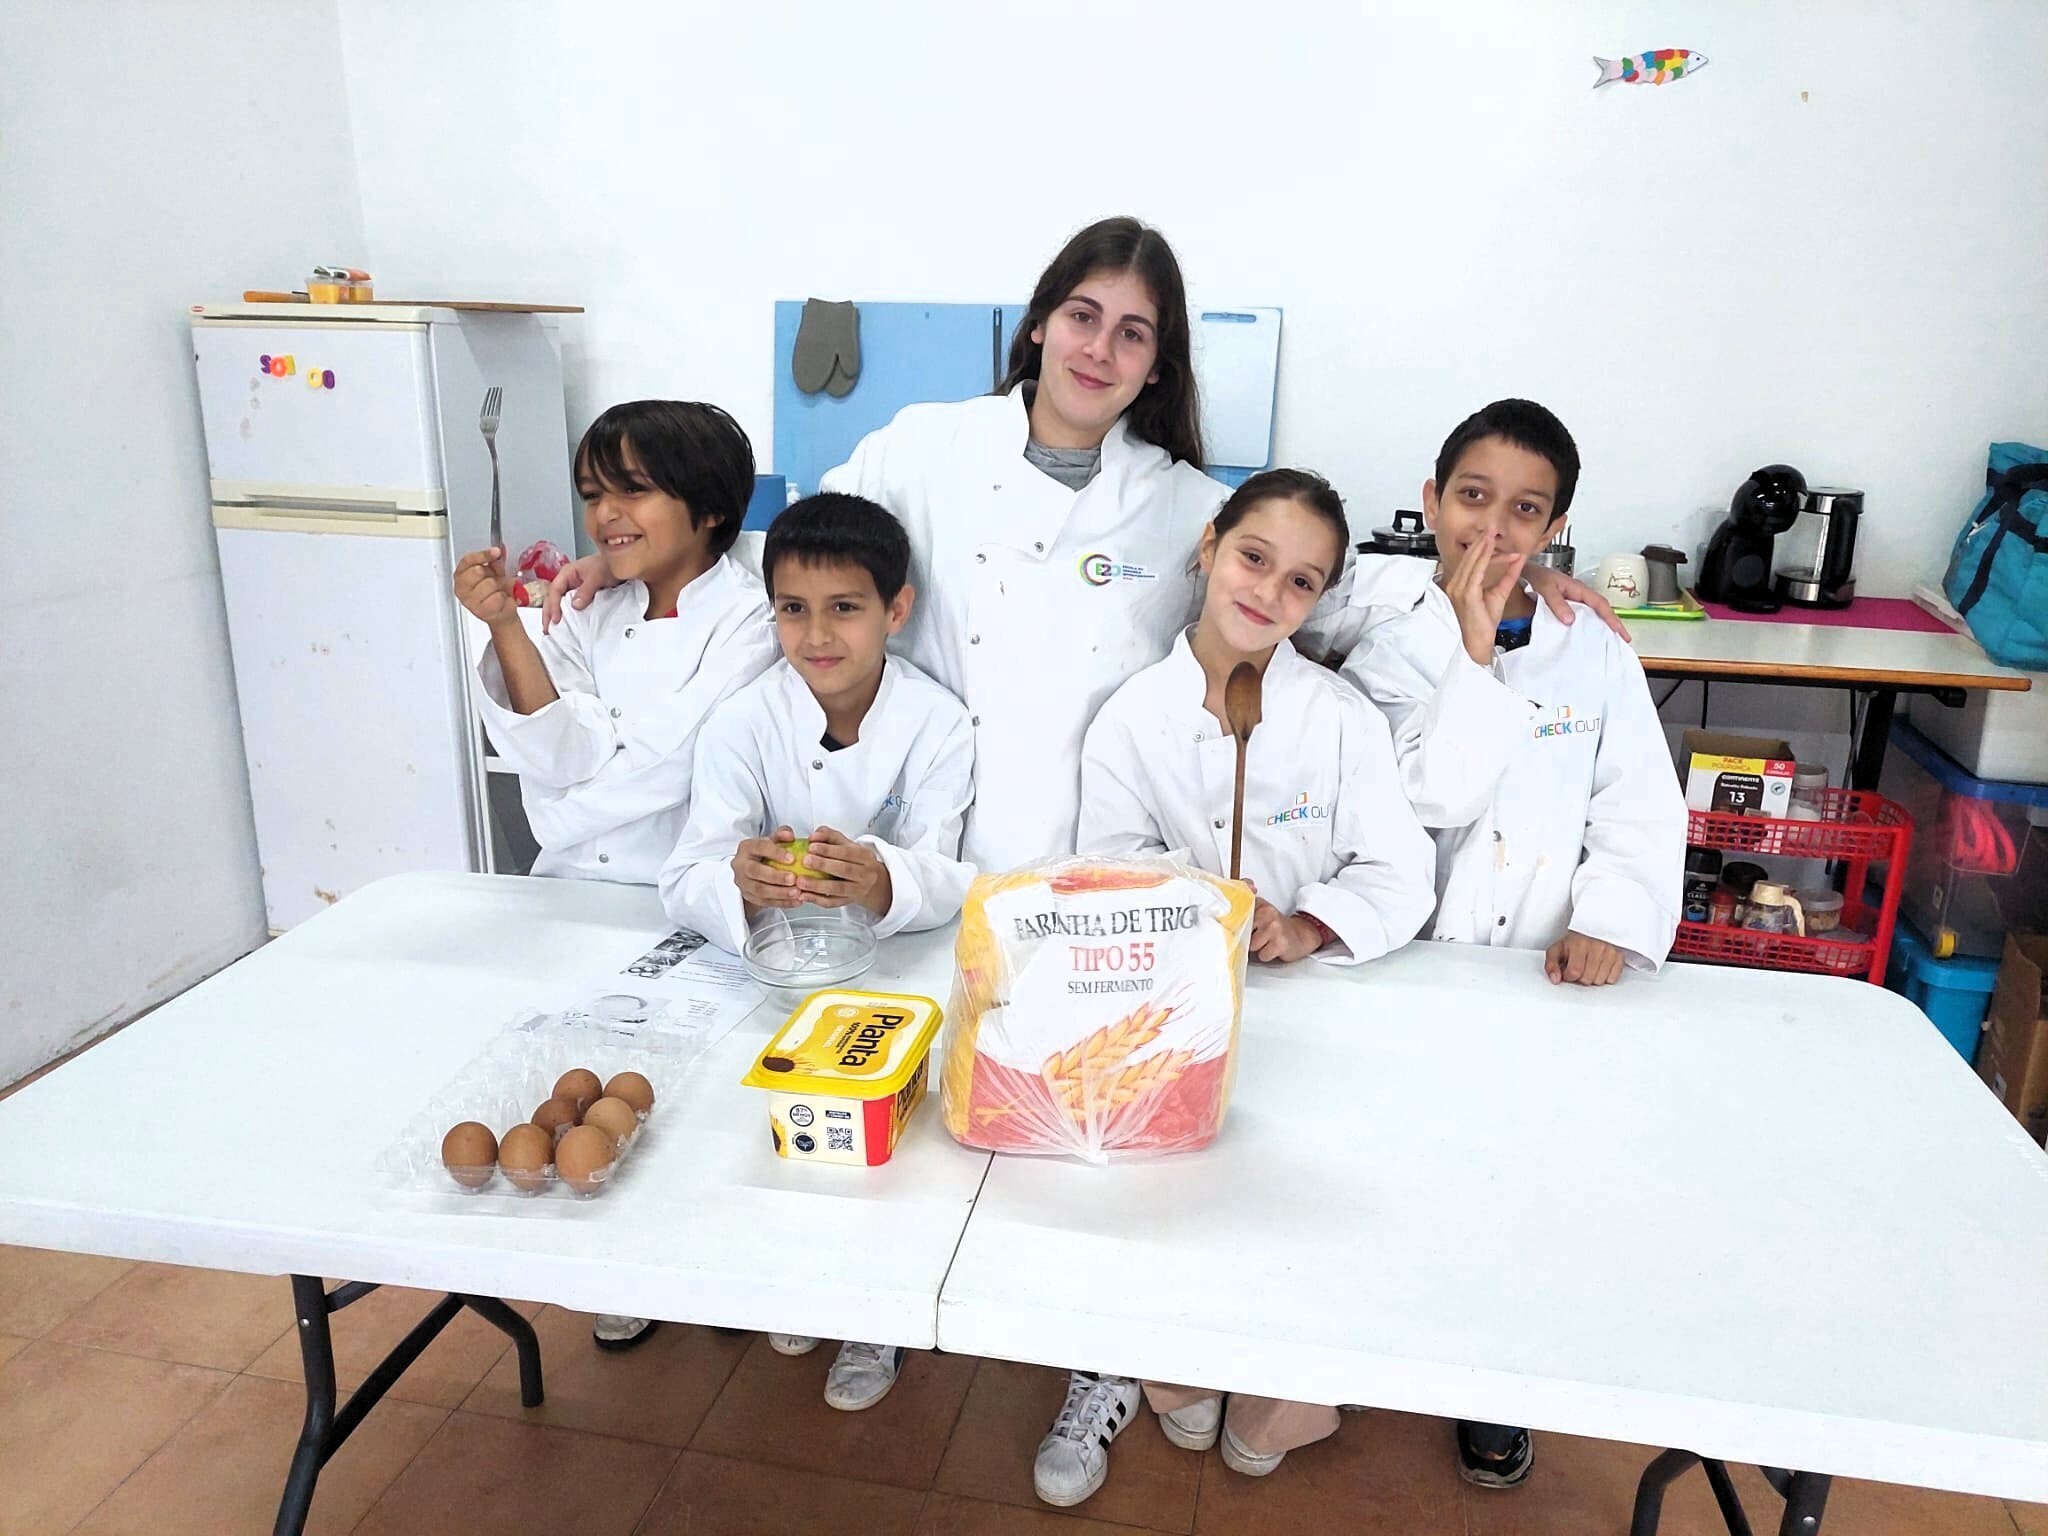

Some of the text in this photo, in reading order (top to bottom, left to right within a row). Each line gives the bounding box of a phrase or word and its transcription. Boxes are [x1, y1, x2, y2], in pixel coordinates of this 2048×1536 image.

[1534, 721, 1572, 739] CHECK
[1729, 791, 1746, 804] 13
[1266, 803, 1331, 826] CHECK OU
[1013, 911, 1107, 940] FARINHA
[1111, 908, 1142, 935] DE
[1069, 942, 1155, 972] TIPO 55
[1067, 977, 1154, 994] SEM FERMENTO
[838, 1013, 905, 1067] Planta
